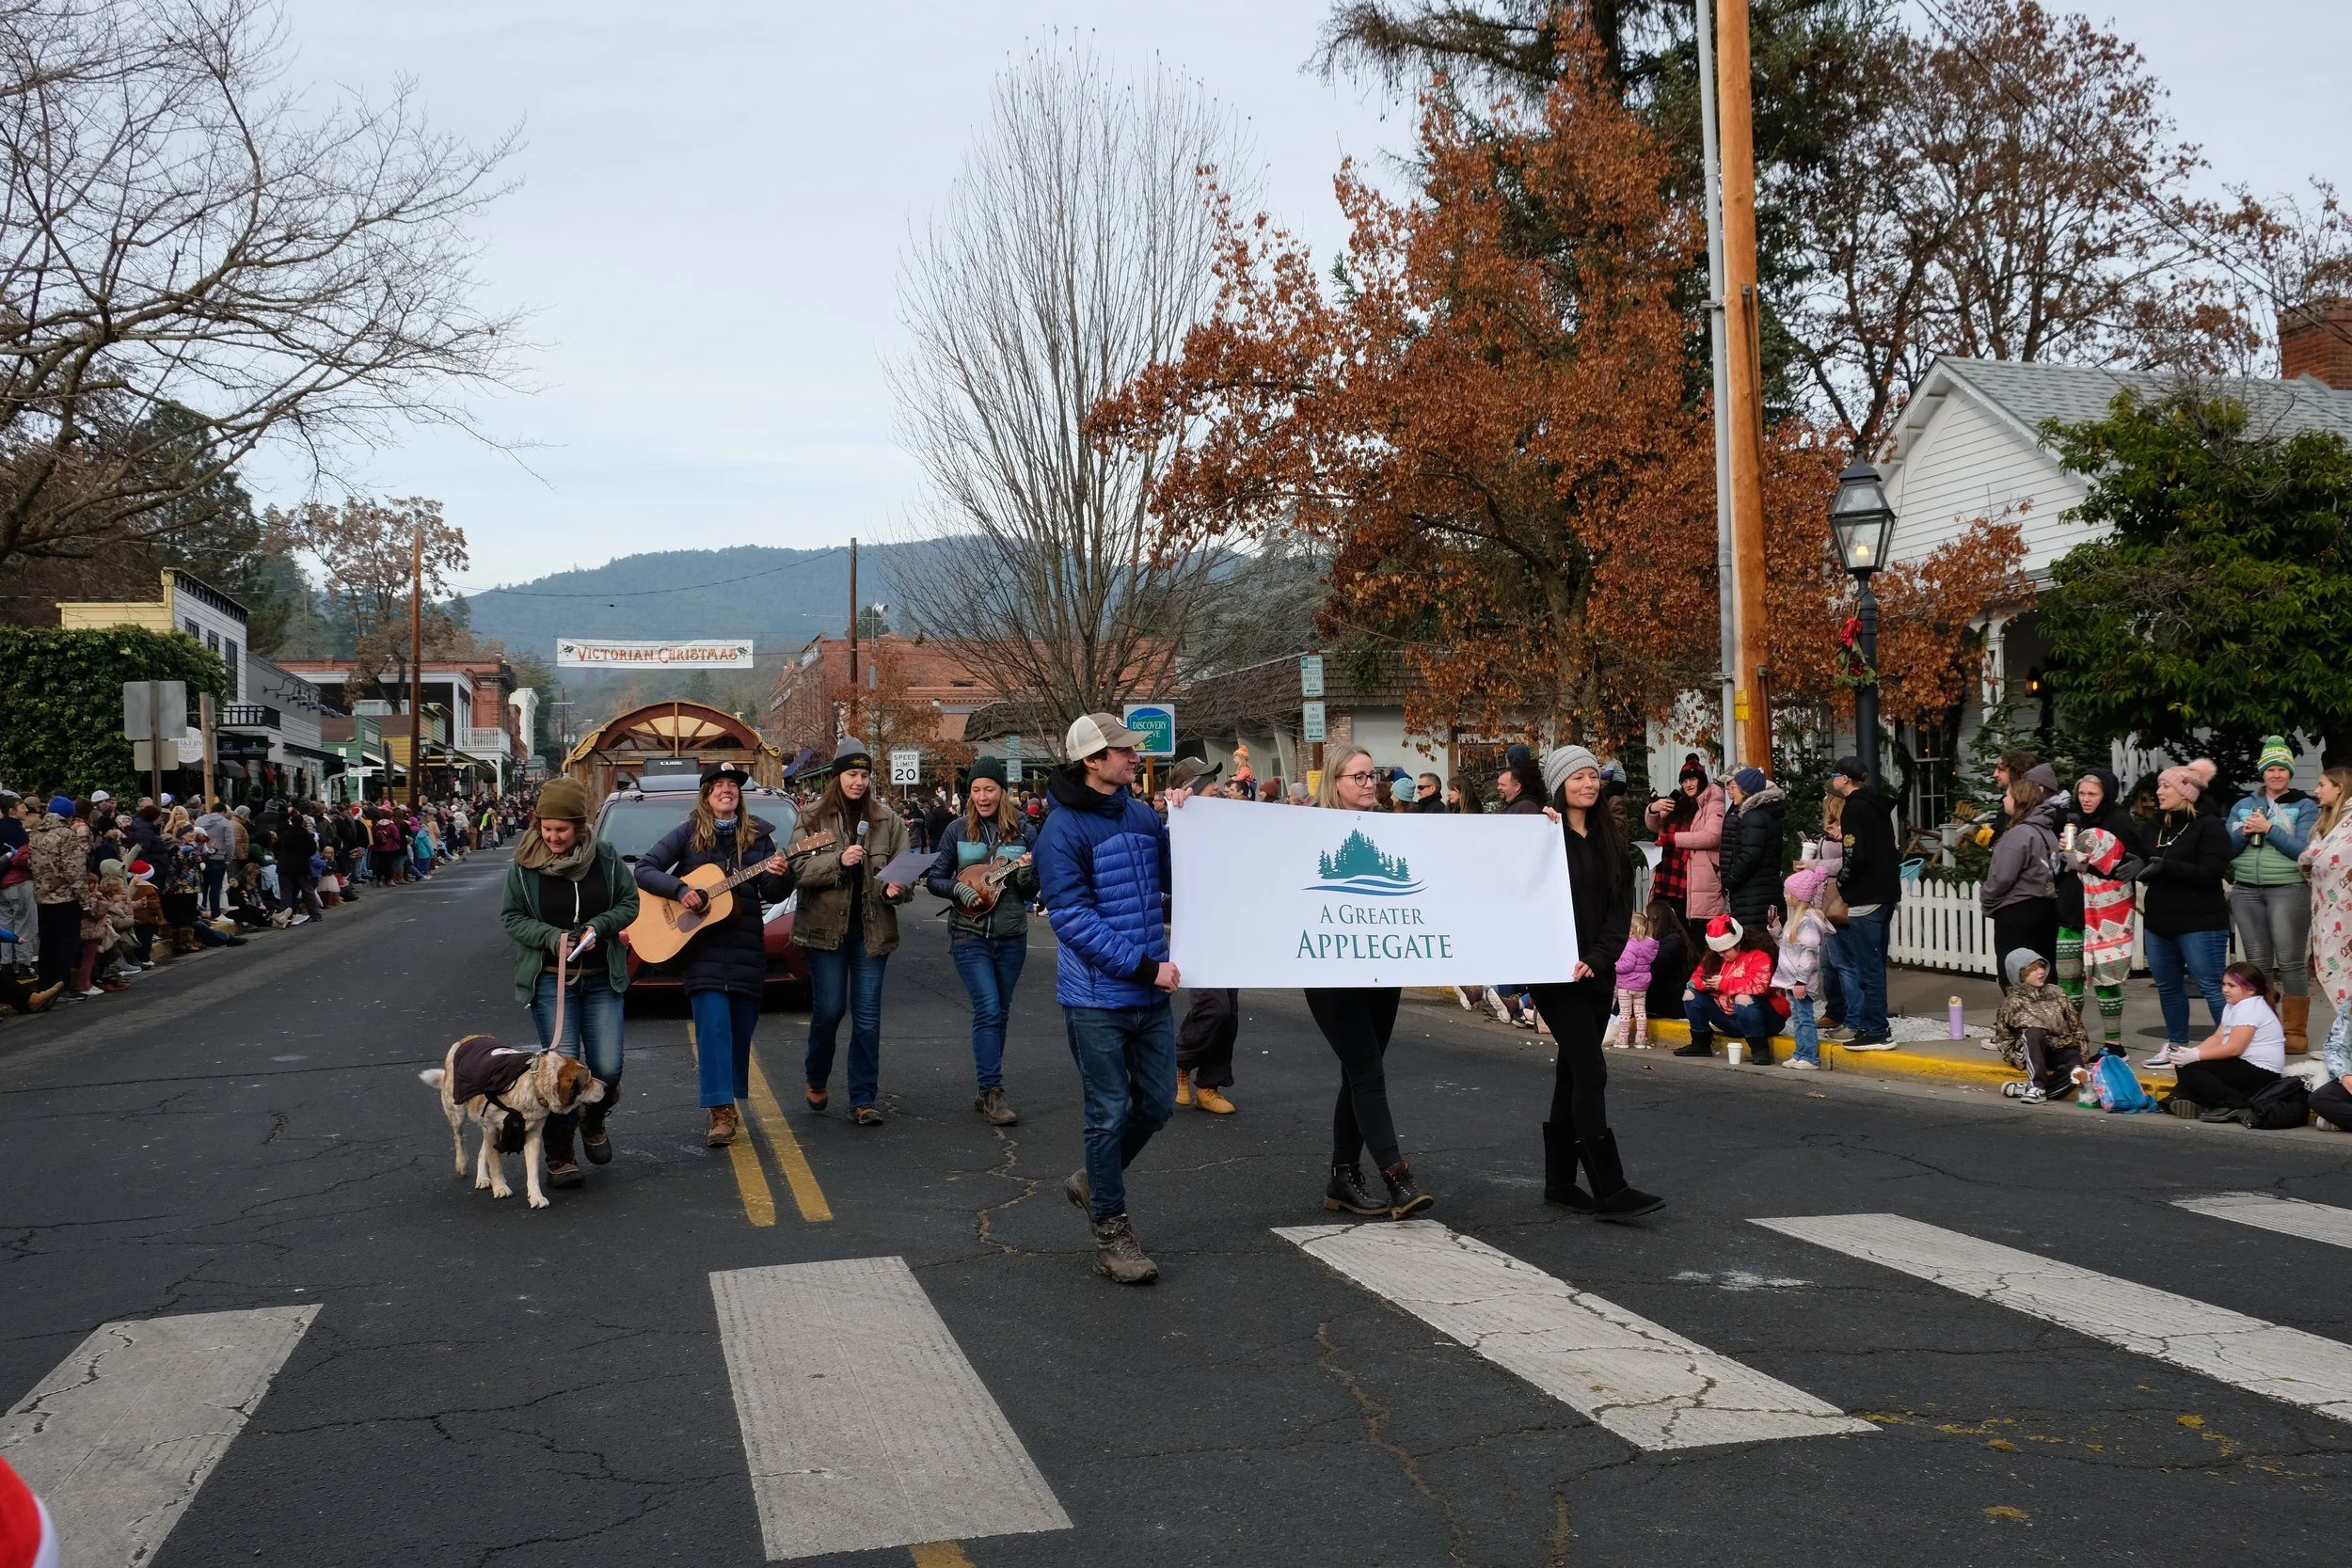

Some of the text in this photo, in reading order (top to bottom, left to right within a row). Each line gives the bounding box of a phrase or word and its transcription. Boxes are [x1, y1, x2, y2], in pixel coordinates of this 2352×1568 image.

[577, 646, 738, 663] VICTORIAN CHRISTMAS
[1133, 721, 1167, 729] DISCOVERY
[895, 768, 915, 780] 20
[1320, 904, 1425, 925] A GREATER
[1295, 928, 1454, 959] APPLEGATE
